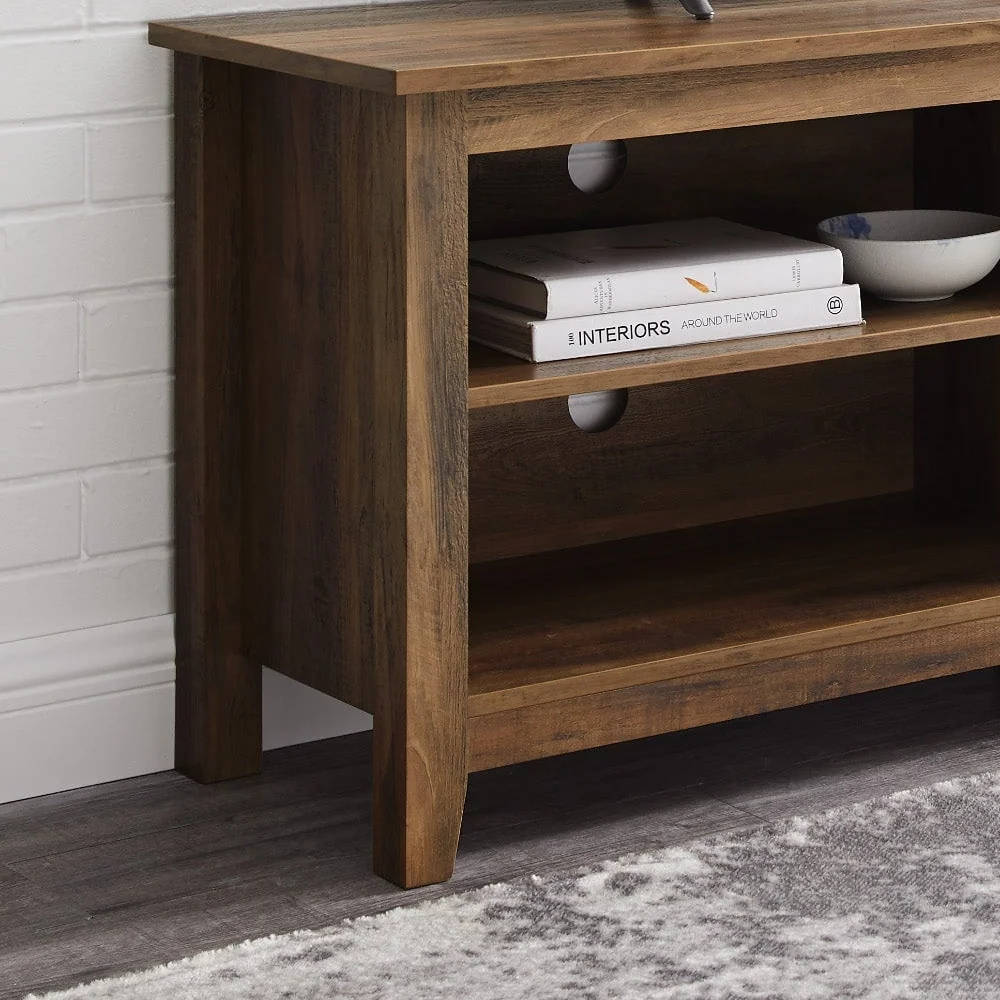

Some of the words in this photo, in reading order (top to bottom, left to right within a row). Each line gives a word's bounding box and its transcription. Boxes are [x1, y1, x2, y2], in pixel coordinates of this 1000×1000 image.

[578, 320, 671, 346] INTERIORS
[681, 315, 723, 330] AROUND
[724, 312, 743, 325] THE
[743, 308, 778, 322] WORLD
